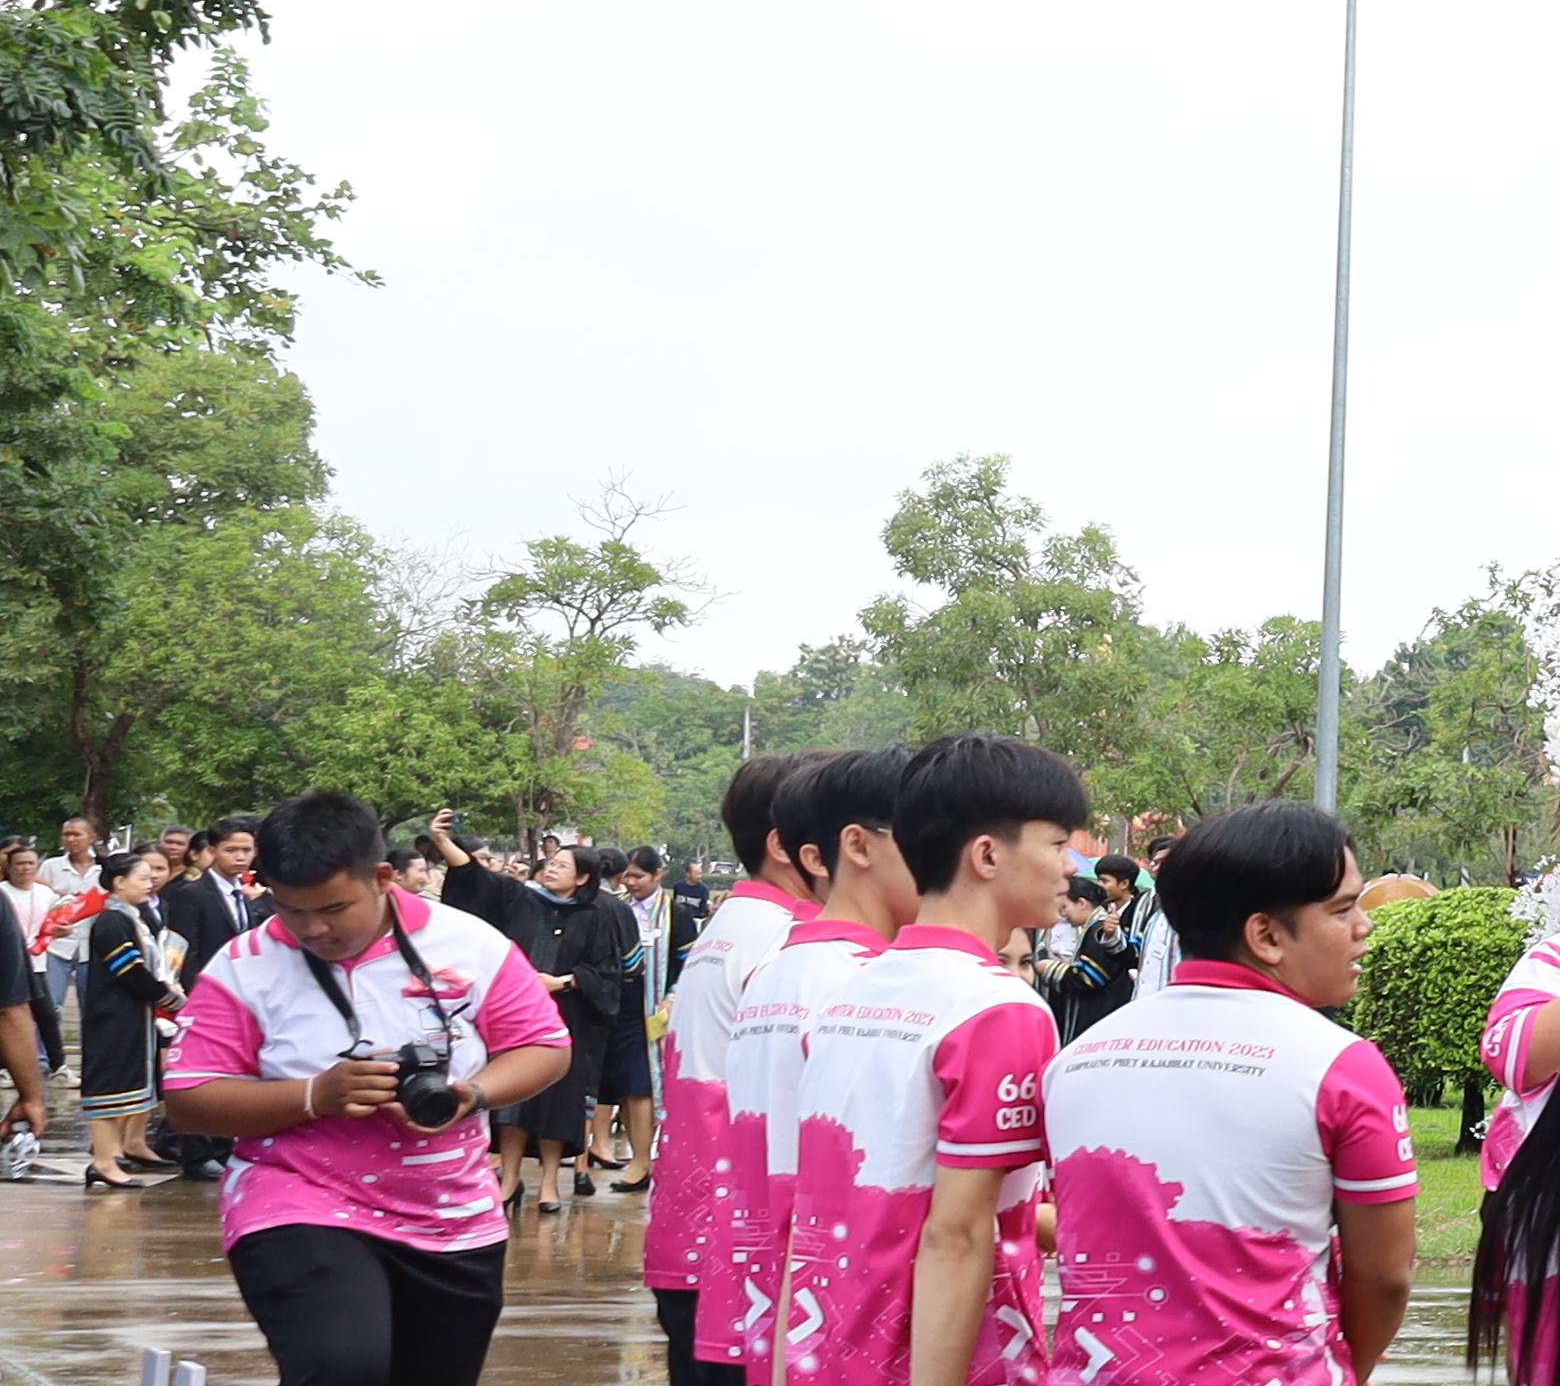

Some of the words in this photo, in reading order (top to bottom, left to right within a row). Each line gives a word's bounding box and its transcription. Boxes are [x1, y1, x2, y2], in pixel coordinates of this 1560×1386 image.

[1136, 1038, 1226, 1053] EDUCATION
[1227, 1042, 1276, 1060] 2023
[997, 1073, 1036, 1102] 66
[995, 1105, 1037, 1130] CED
